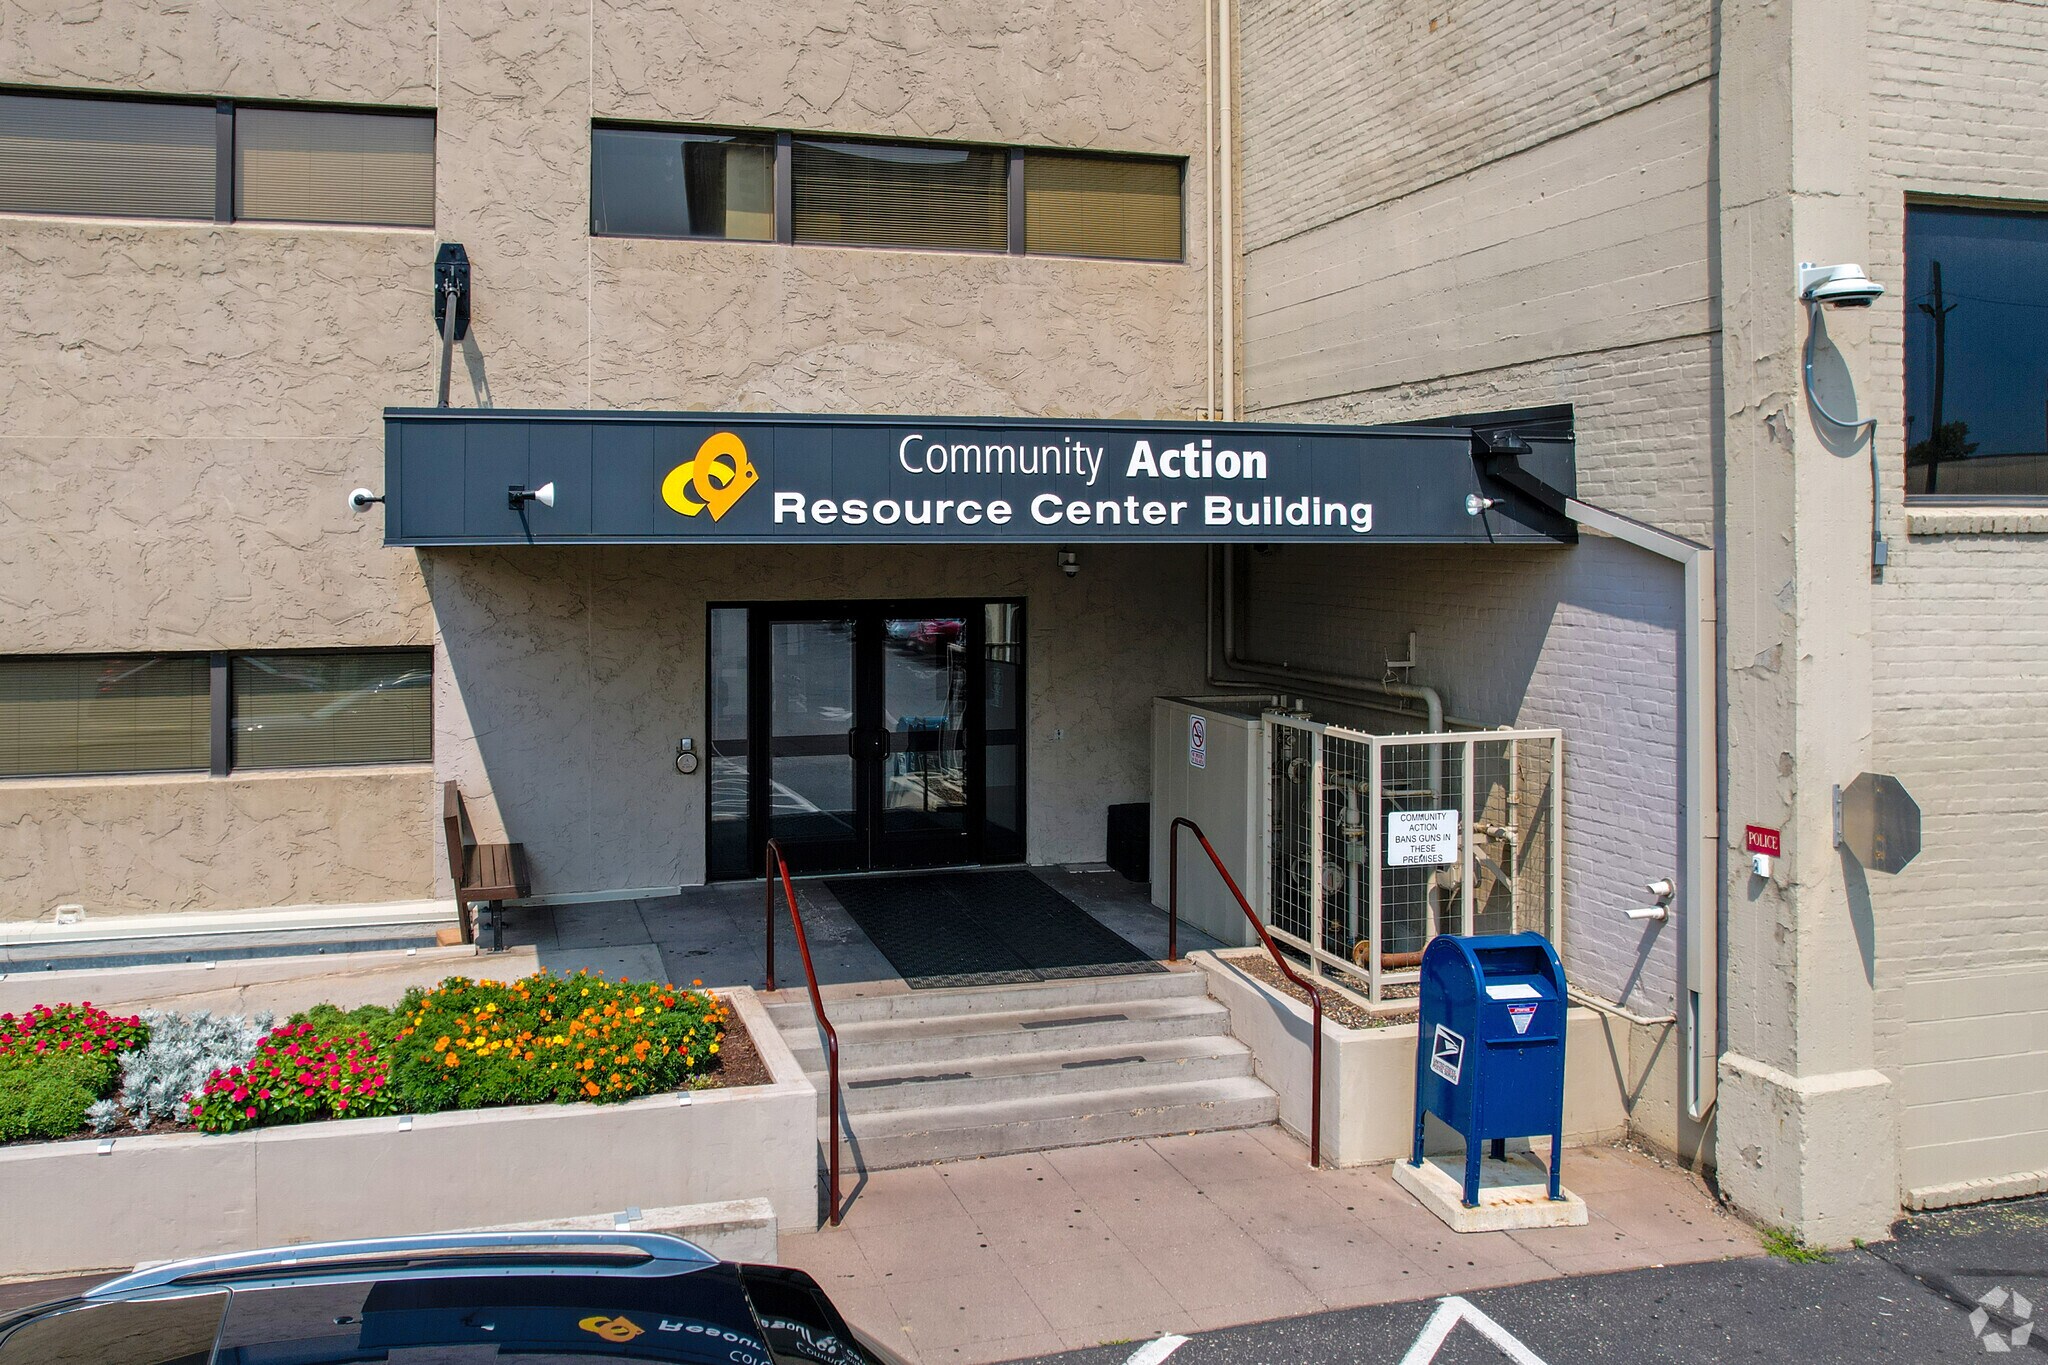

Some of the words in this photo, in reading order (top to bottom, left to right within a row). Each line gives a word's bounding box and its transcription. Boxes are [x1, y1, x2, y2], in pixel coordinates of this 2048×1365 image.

[899, 434, 1104, 486] Community
[1125, 439, 1268, 479] Action
[773, 491, 1013, 526] Resource
[1030, 493, 1188, 526] Center
[1203, 495, 1373, 533] Building
[1400, 812, 1447, 822] COMMUNITY
[1409, 823, 1438, 831] ACTION
[1395, 835, 1417, 843] BANS
[1418, 834, 1441, 843] GUNS
[1443, 833, 1451, 841] IN
[1748, 831, 1778, 850] POLICE
[1410, 844, 1436, 853] THESE
[1402, 854, 1443, 864] PREMISES
